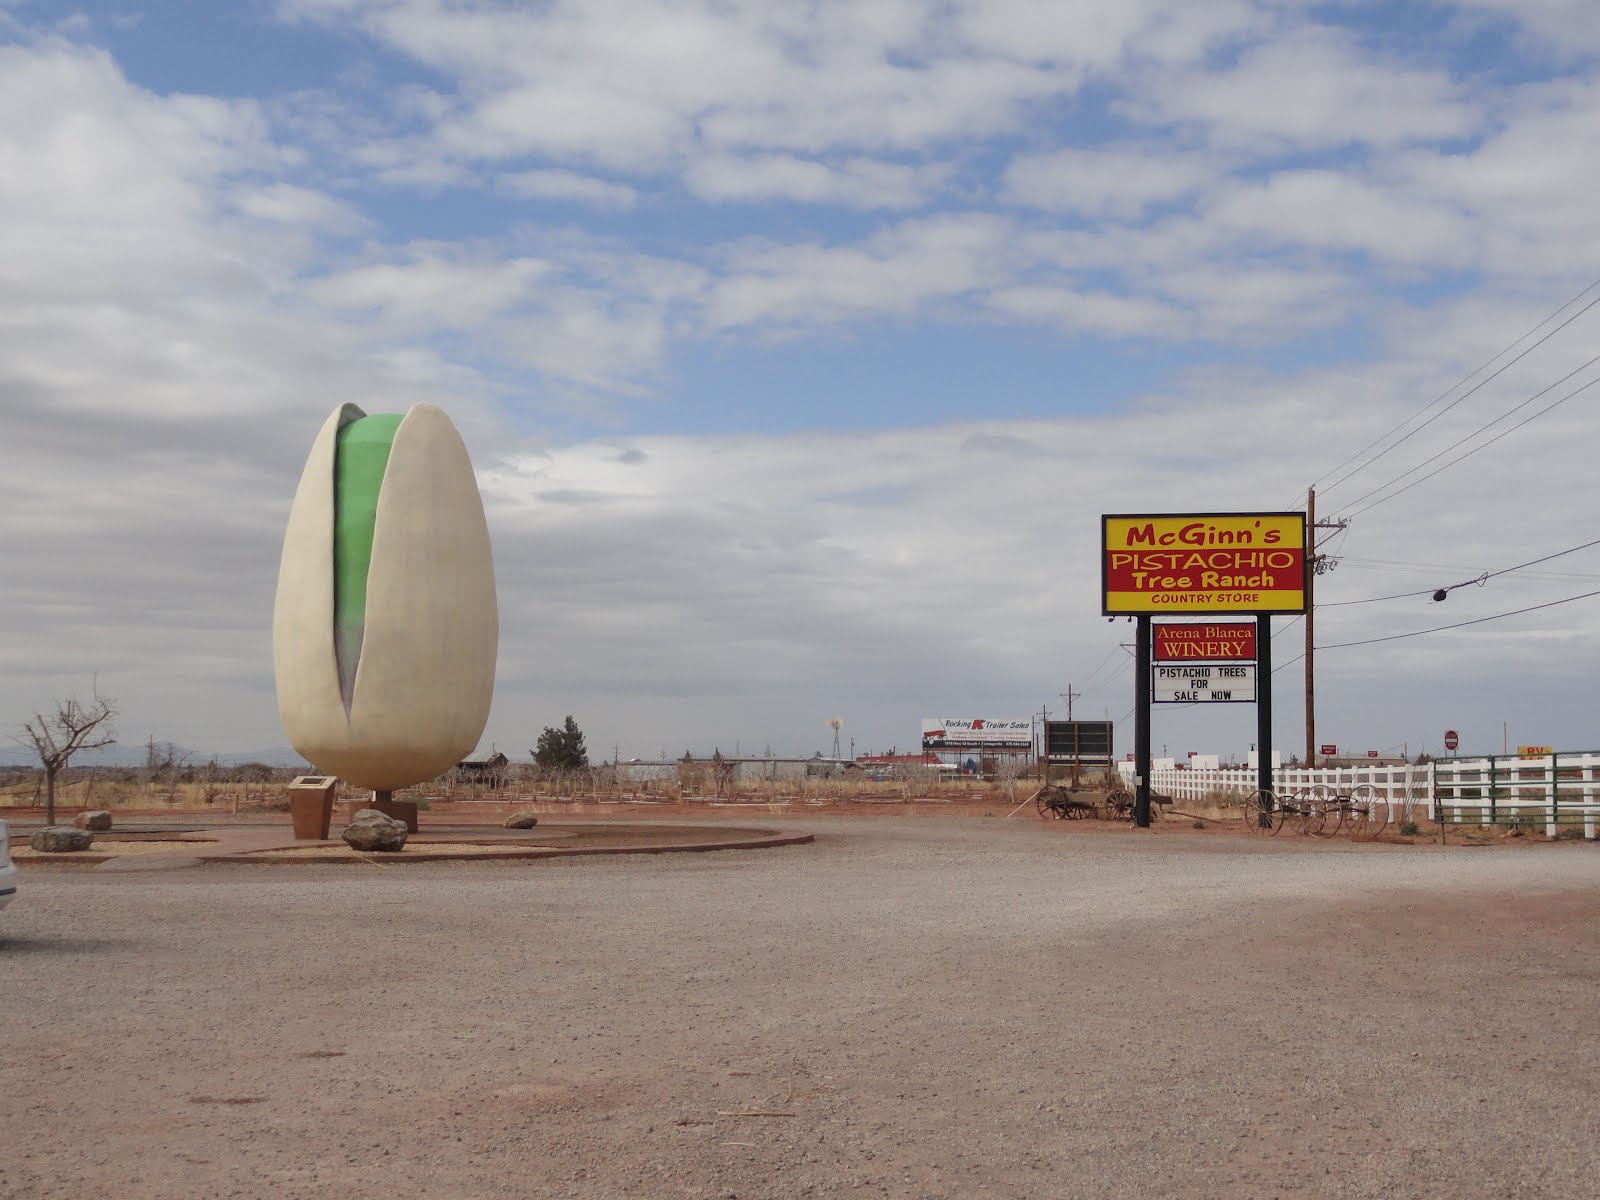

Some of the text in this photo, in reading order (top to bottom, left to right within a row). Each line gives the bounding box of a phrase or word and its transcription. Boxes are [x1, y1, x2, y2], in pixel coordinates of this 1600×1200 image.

[1126, 520, 1280, 546] McGinn's
[1112, 552, 1294, 570] PISTACHIO
[1132, 570, 1274, 589] Tree Ranch
[1151, 593, 1259, 604] COUNTRY STORE
[1157, 626, 1252, 639] Arena Blanca
[1163, 641, 1247, 657] WINERY
[1159, 667, 1247, 678] PISTACHIO TREES
[1190, 679, 1209, 689] FOR
[1174, 690, 1232, 701] SALE NOW
[945, 719, 971, 729] Rocking
[986, 721, 1009, 729] Trailer
[1010, 721, 1030, 729] Sales
